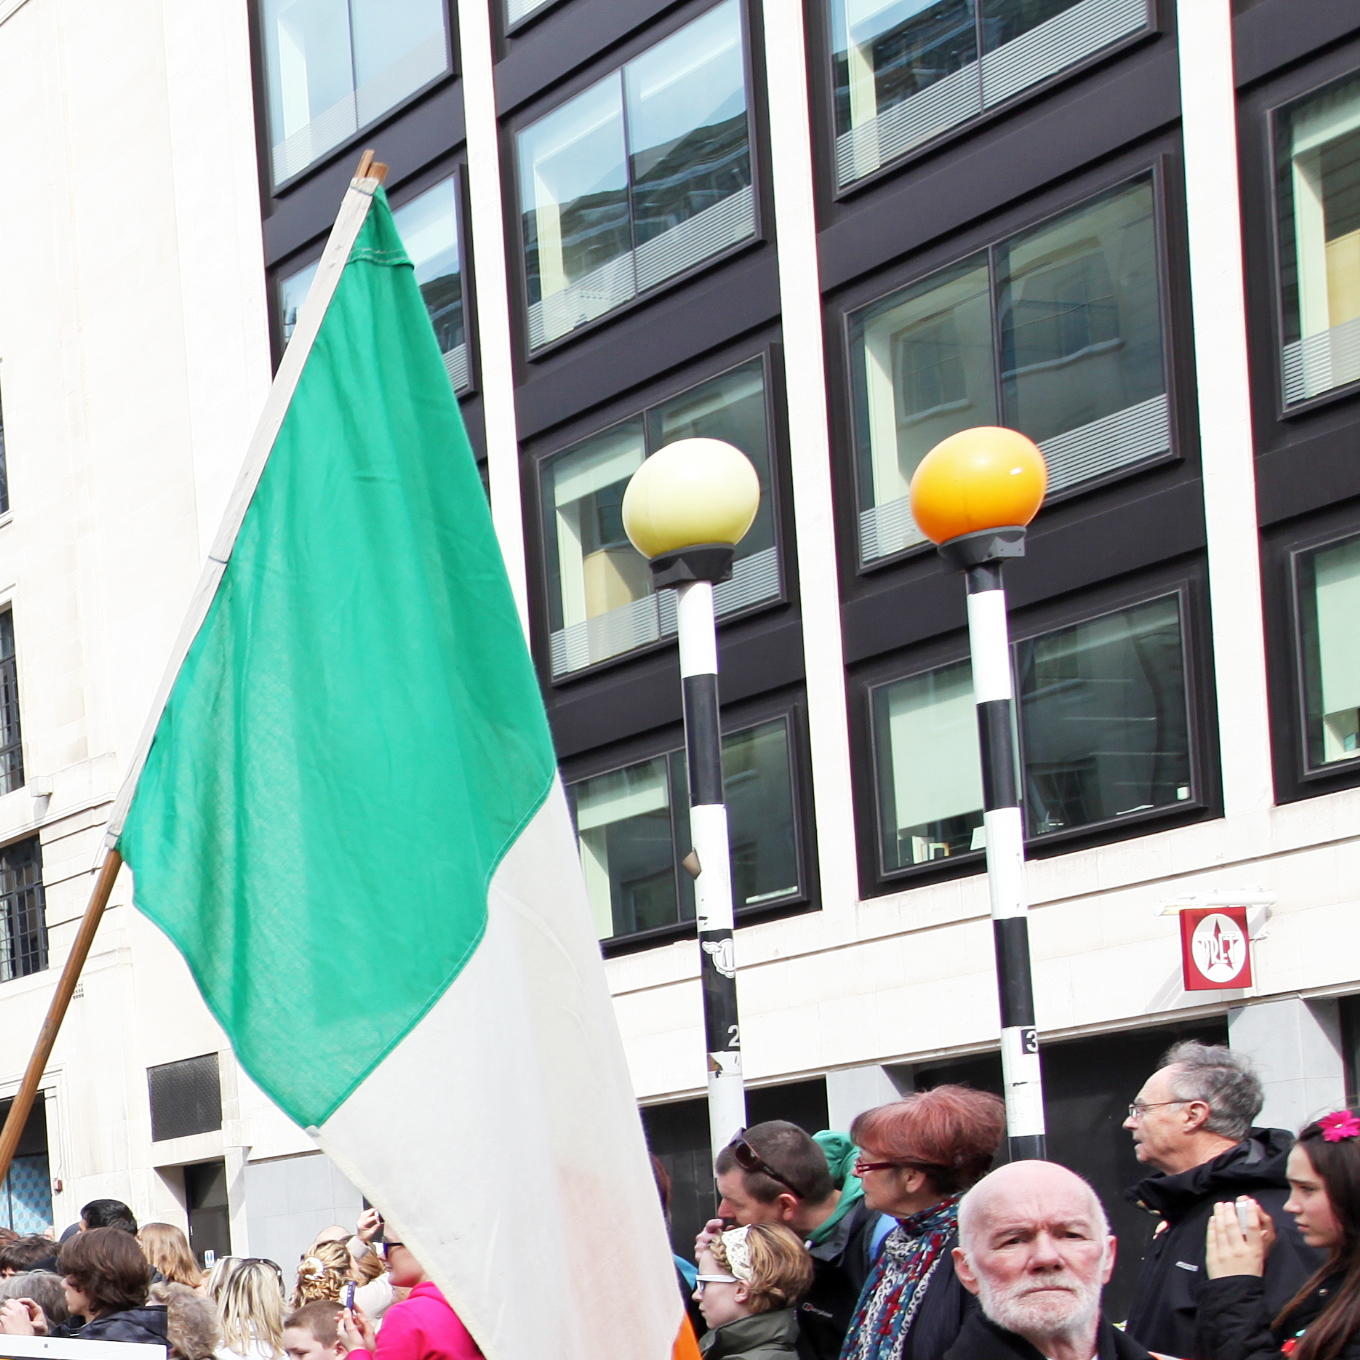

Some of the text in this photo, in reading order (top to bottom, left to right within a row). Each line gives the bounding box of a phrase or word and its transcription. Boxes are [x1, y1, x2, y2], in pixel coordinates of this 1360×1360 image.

[1199, 932, 1240, 964] PRET
[727, 1025, 740, 1047] 2
[1026, 1030, 1038, 1053] 3
